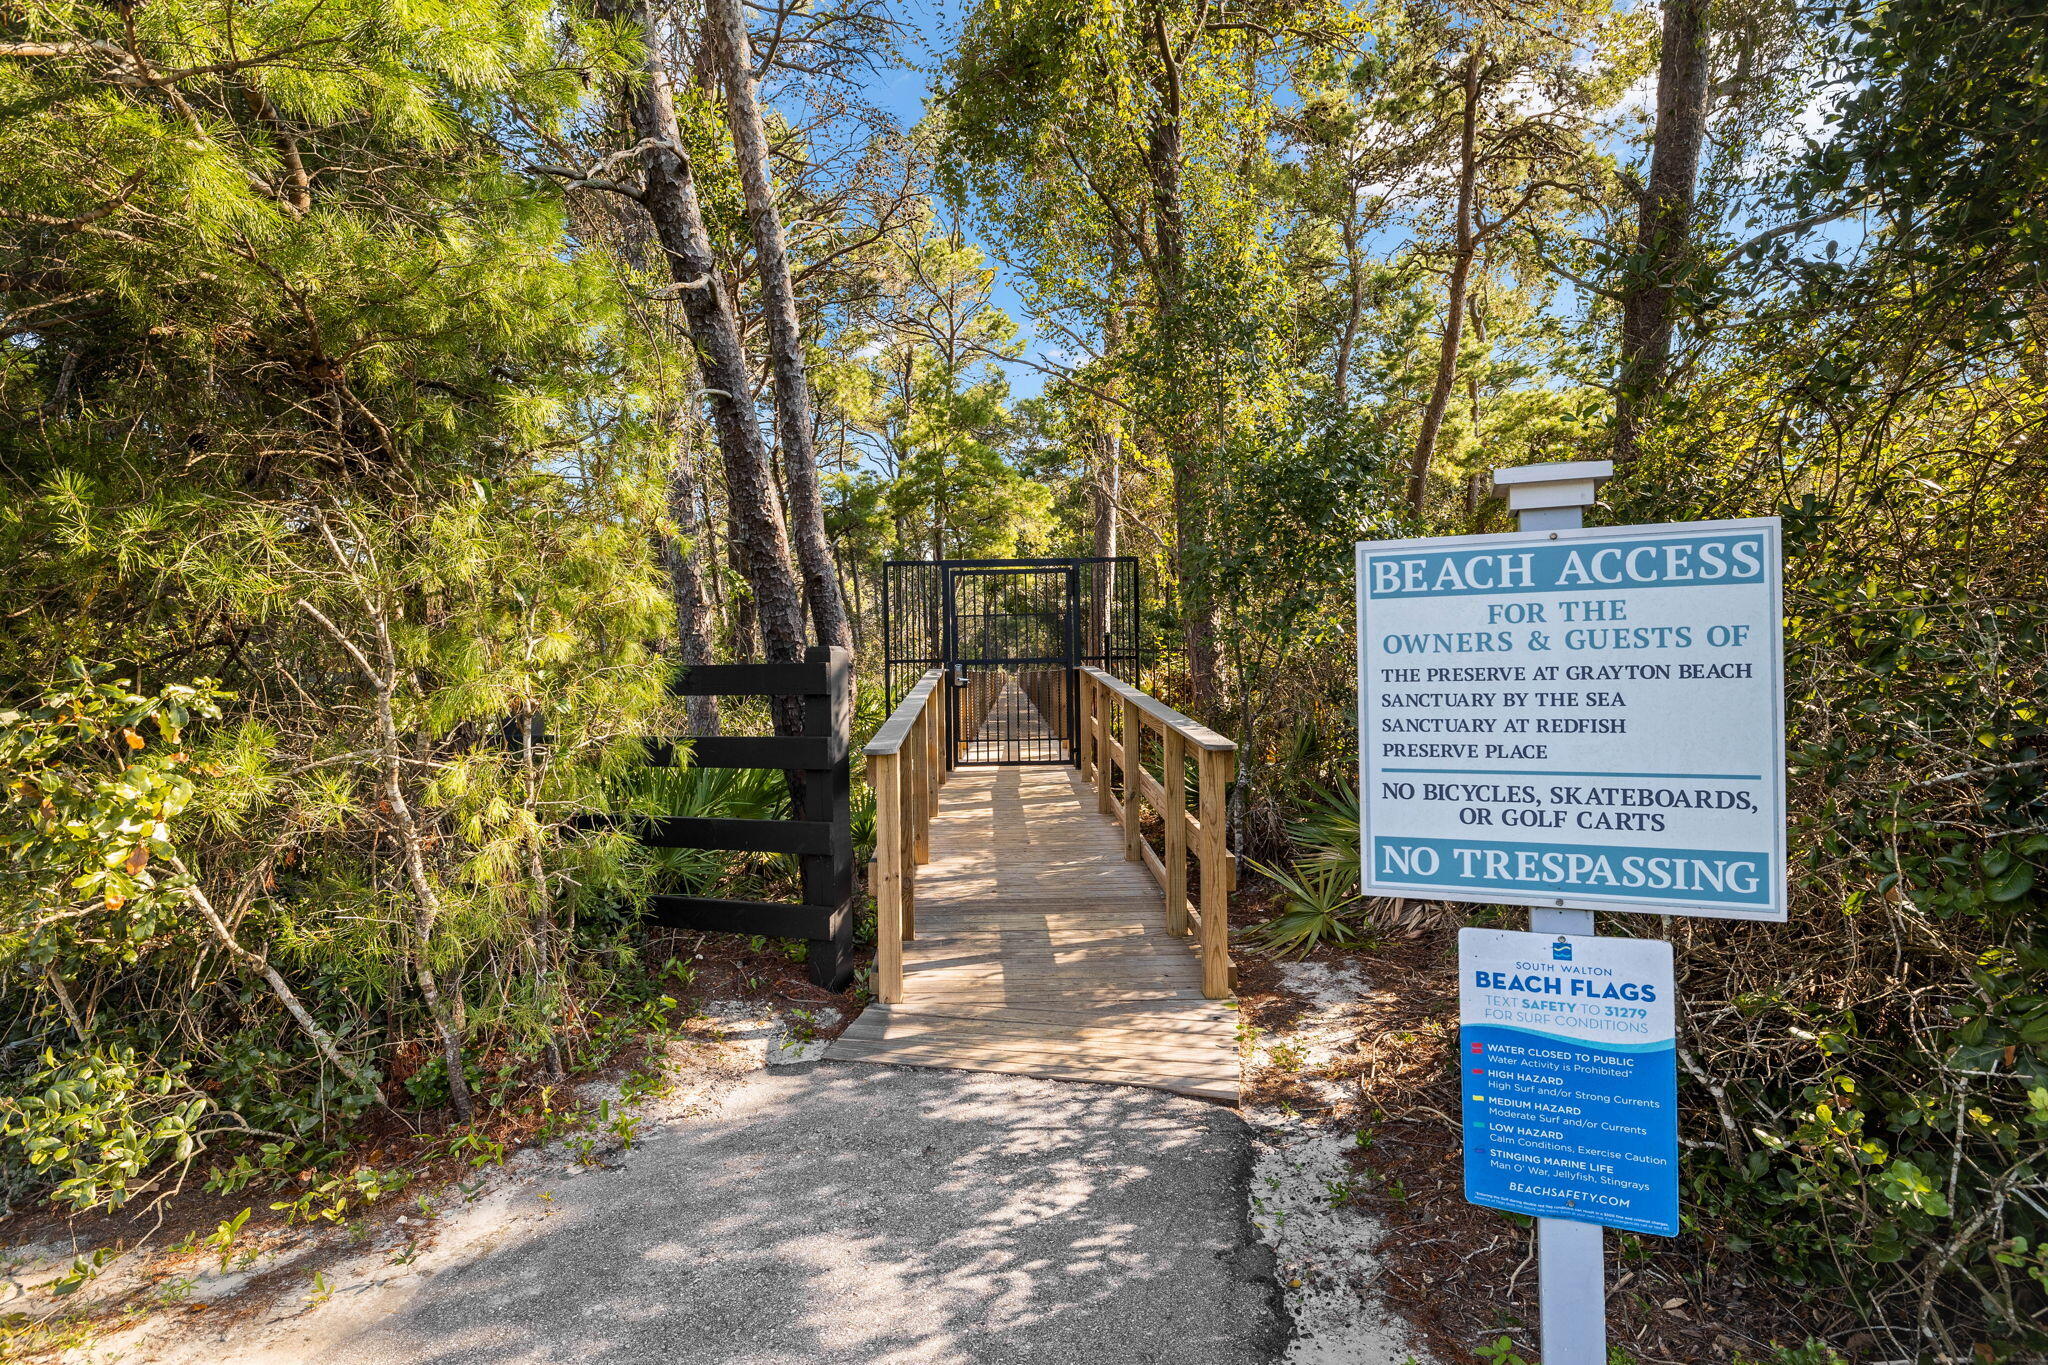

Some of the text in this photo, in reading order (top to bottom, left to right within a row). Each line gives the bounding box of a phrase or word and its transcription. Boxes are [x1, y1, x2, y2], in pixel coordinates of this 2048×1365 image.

[1372, 541, 1761, 593] BEACH ACCESS
[1488, 600, 1627, 624] FOR THE
[1383, 625, 1750, 654] OWNERS & GUESTS OF
[1382, 664, 1752, 682] THE PRESERVE AT GRAYTON BEACH
[1382, 692, 1626, 707] SANCTUARY BY THE SEA
[1382, 719, 1626, 733] SANCTUARY AT REDFISH
[1383, 744, 1548, 759] PRESERVE PLACE
[1382, 782, 1759, 814] NO BICYCLES, SKATEBOARDS,
[1459, 808, 1665, 831] OR GOLF CARTS
[1382, 845, 1760, 894] NO TRESPASSING
[1516, 962, 1612, 976] SOUTH WALTON
[1476, 971, 1656, 1002] BEACH FLAGS
[1486, 995, 1647, 1019] TEXT SAFETY TO 31279
[1485, 1009, 1648, 1033] FOR SURF CONDITIONS
[1488, 1044, 1525, 1055] WATER
[1528, 1049, 1571, 1060] CLOSED
[1594, 1055, 1634, 1067] PUBLIC
[1488, 1056, 1517, 1065] Water
[1521, 1060, 1559, 1071] Activity
[1563, 1063, 1571, 1071] is
[1488, 1070, 1563, 1085] HIGH HAZARD
[1489, 1082, 1660, 1108] High Surf and/or Strong Currents
[1489, 1097, 1581, 1115] MEDIUM HAZARD
[1489, 1108, 1647, 1135] Moderate Surf and/or Currents
[1489, 1123, 1563, 1139] LOW HAZARD
[1490, 1134, 1667, 1165] Calm Conditions, Exercise Caution
[1491, 1149, 1614, 1173] STINGING MARINE LIFE
[1491, 1161, 1510, 1170] Man
[1553, 1170, 1597, 1183] Jellyfish,
[1601, 1177, 1649, 1191] Stingrays
[1509, 1183, 1630, 1208] BEACHSAFETY.COM
